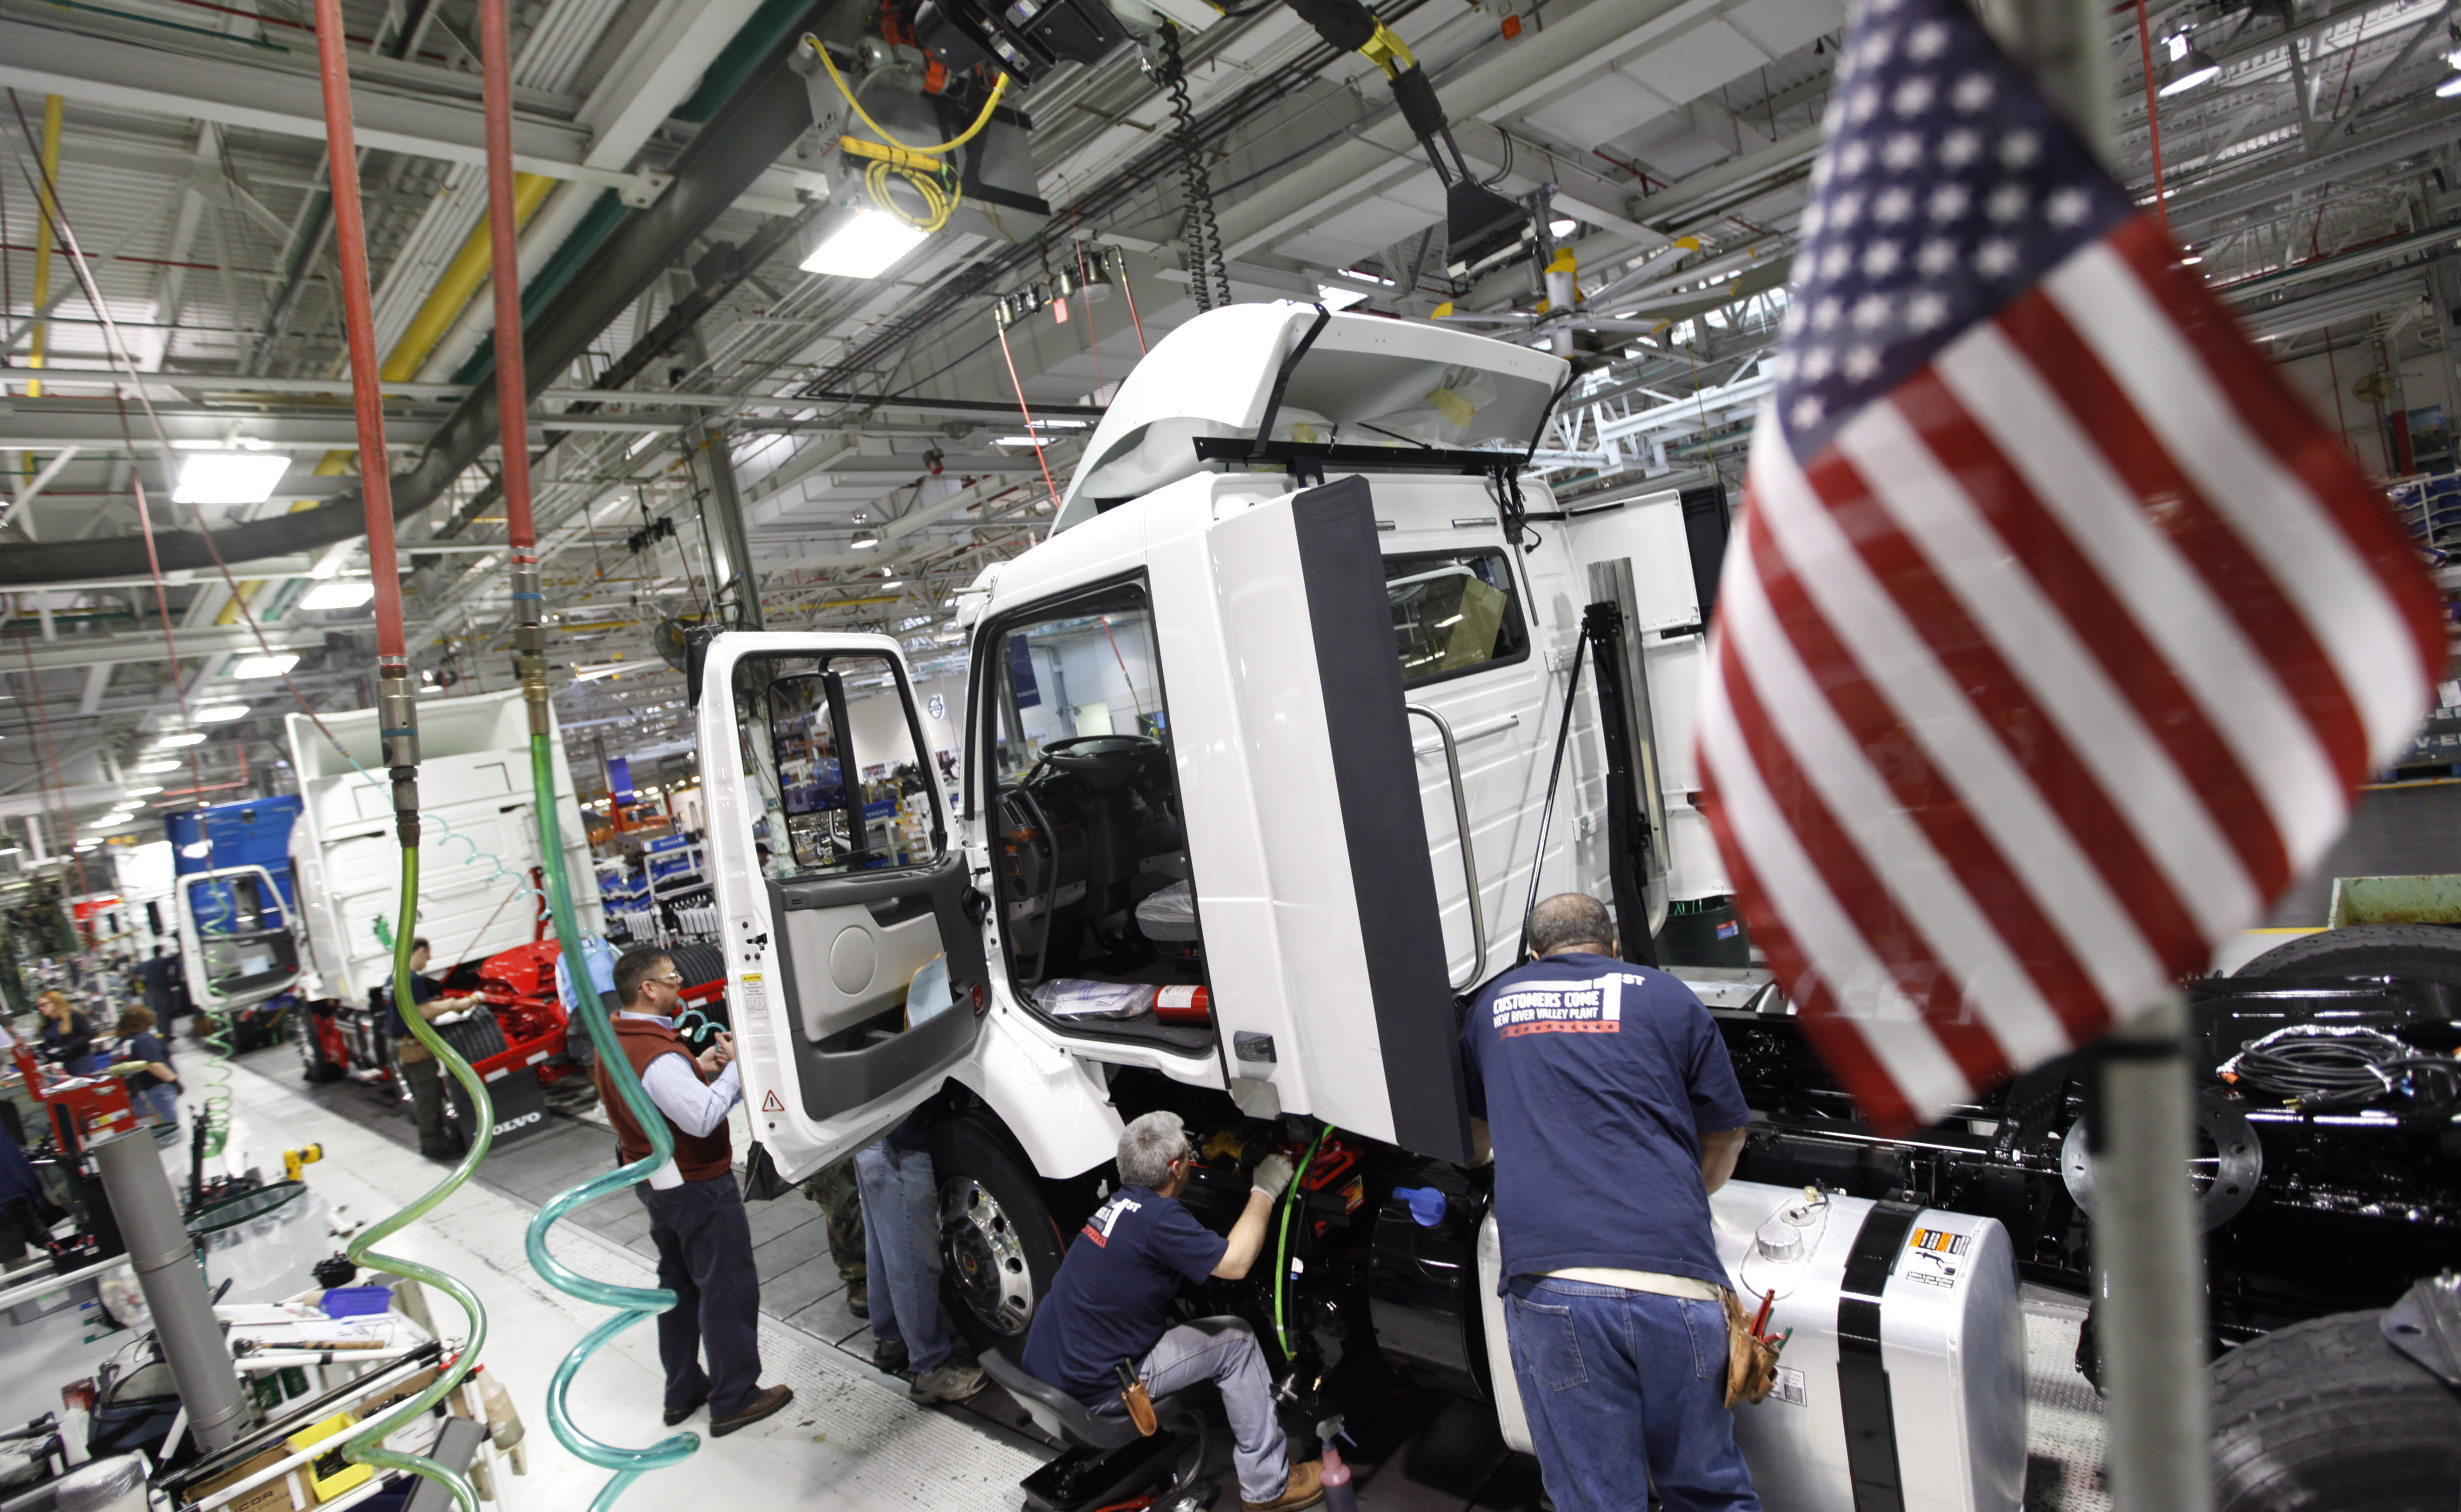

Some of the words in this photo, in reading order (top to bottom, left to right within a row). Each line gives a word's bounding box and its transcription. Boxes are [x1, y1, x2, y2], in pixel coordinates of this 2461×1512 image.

[1016, 689, 1037, 698] VOLVO
[866, 808, 889, 817] VOLVO
[1493, 992, 1561, 1015] CUSTOMERS
[1564, 991, 1600, 1007] COME
[1493, 1012, 1510, 1029] NEW
[1511, 1009, 1535, 1023] RIVER
[1536, 1008, 1568, 1019] VALLEY
[1569, 1007, 1599, 1019] PLANT
[473, 1111, 542, 1136] OLVO
